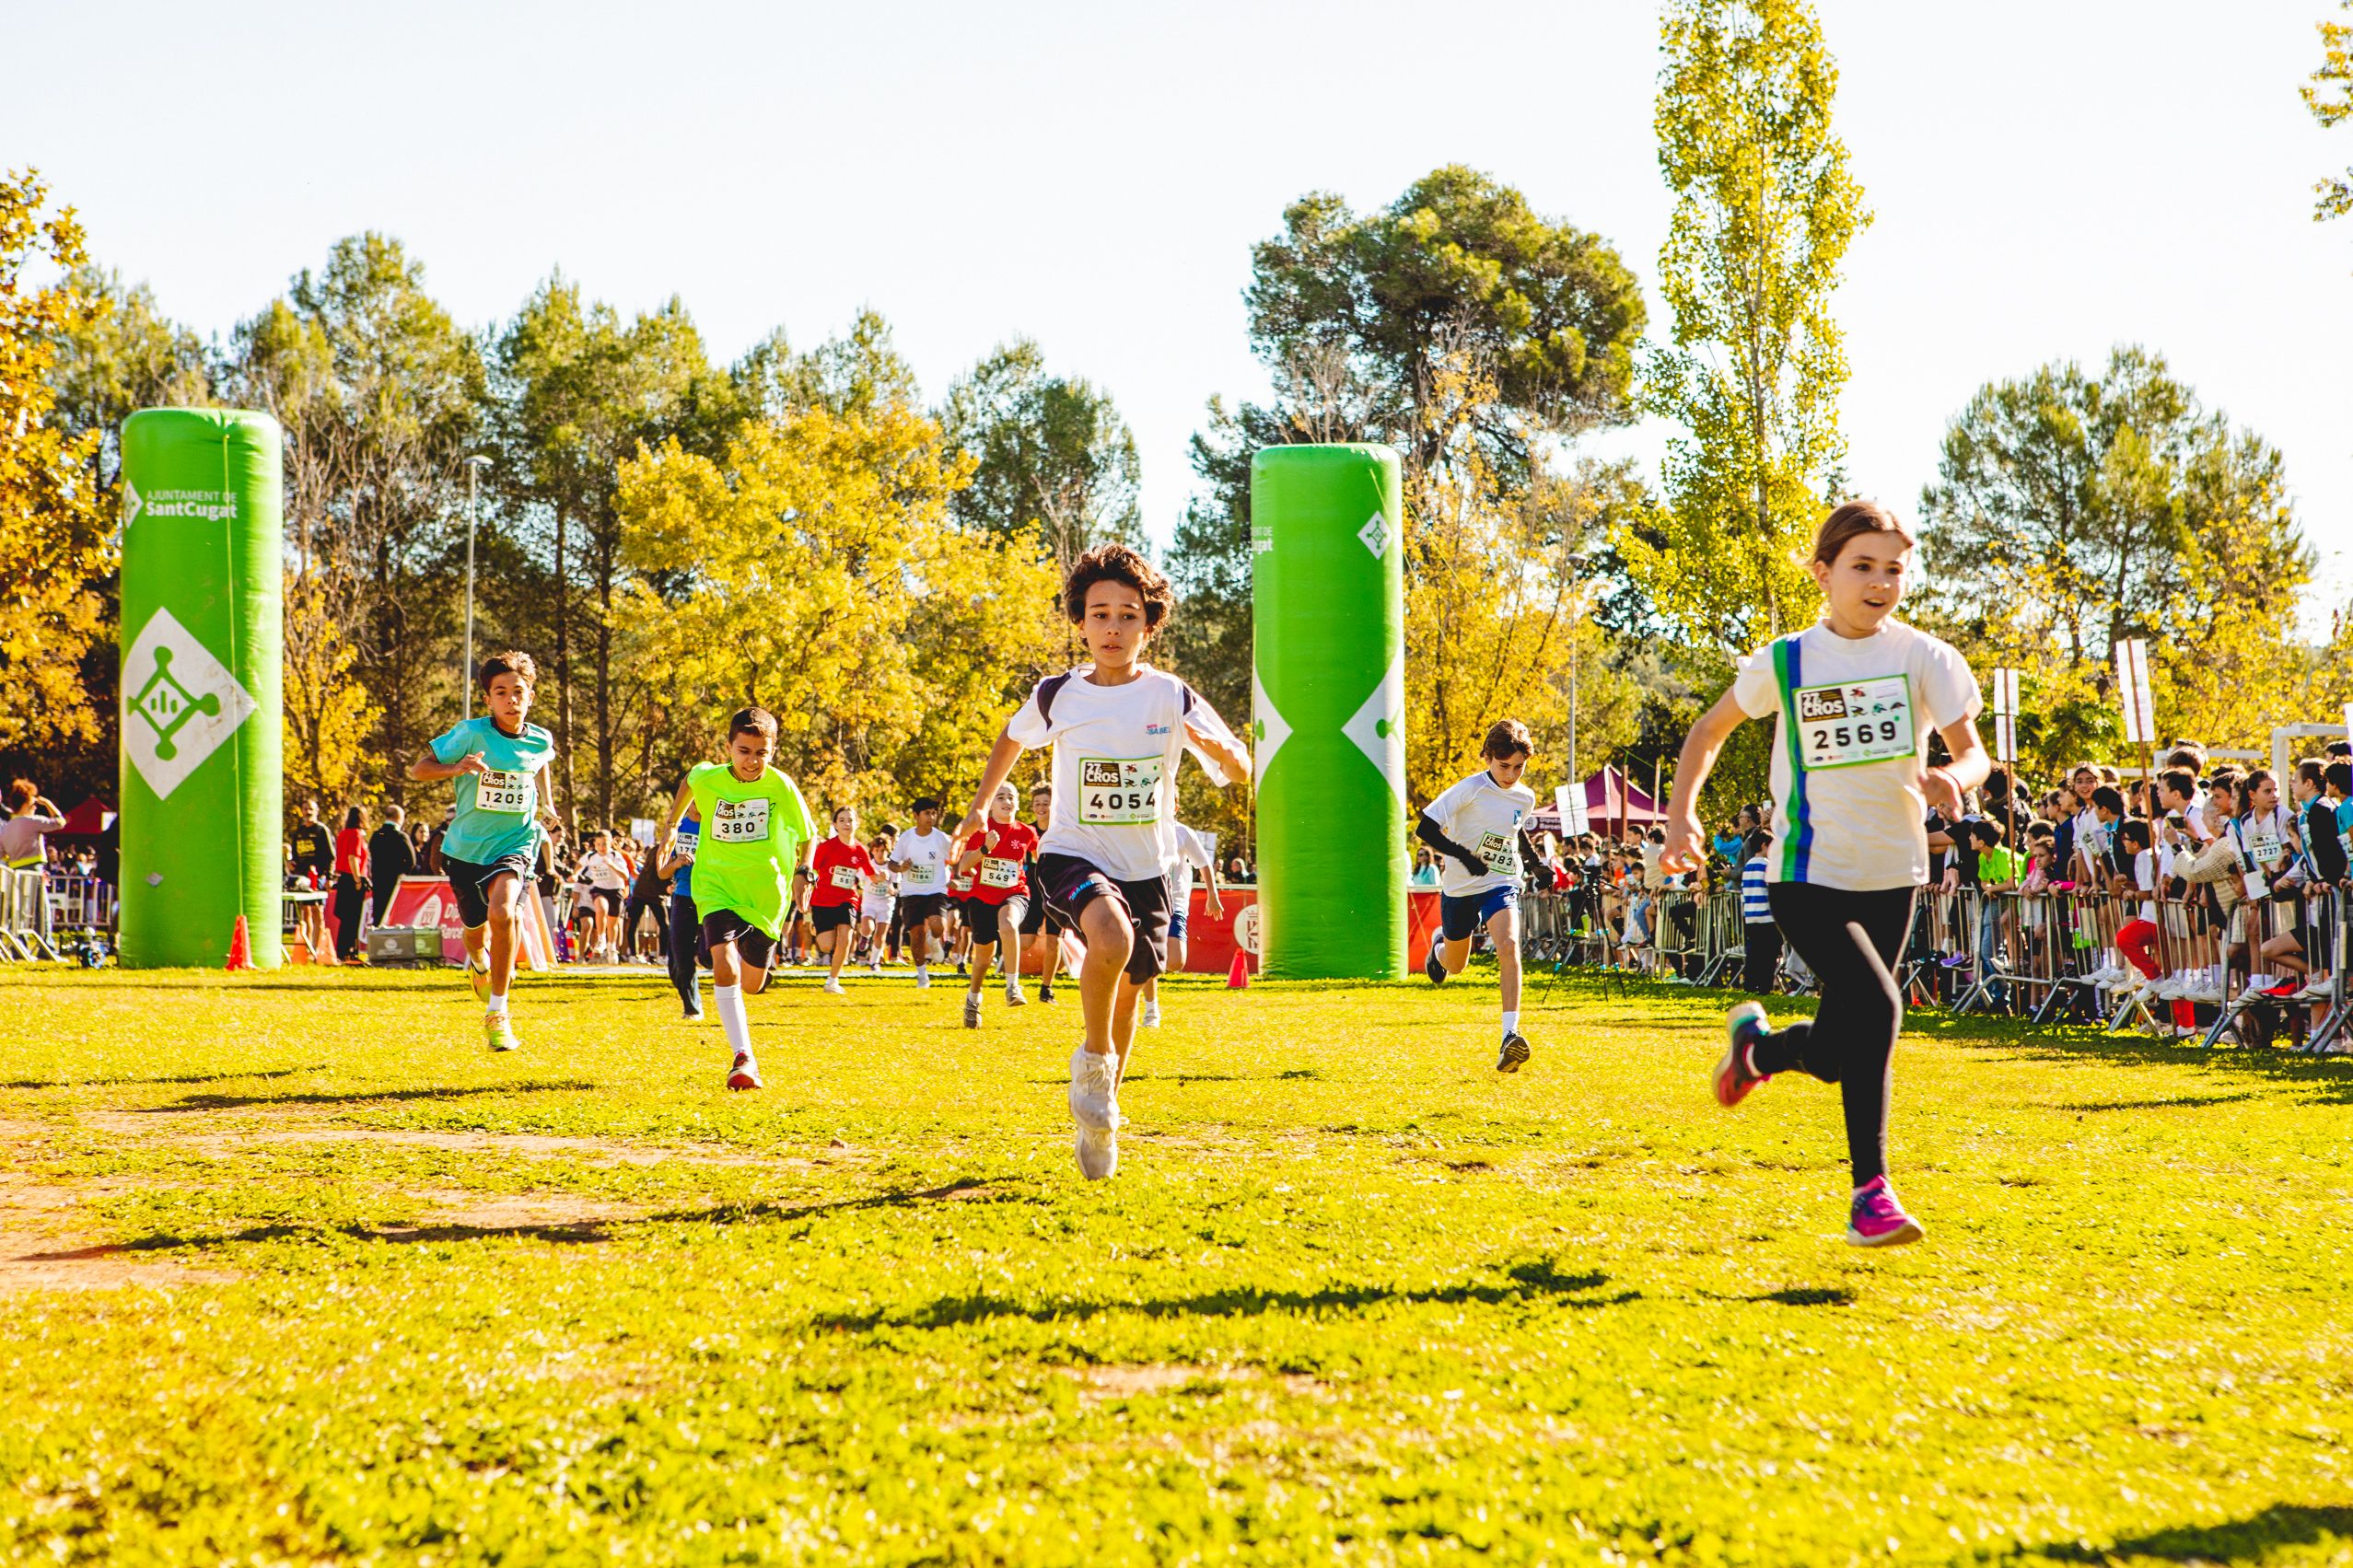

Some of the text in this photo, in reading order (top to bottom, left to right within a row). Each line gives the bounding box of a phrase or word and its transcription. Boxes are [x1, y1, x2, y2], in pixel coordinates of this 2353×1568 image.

[146, 490, 238, 503] AJUNTAMENT DE
[146, 501, 238, 521] SantCugat
[1802, 700, 1845, 717] CROS
[1812, 721, 1897, 749] 2569
[483, 777, 505, 786] CROS
[1085, 772, 1119, 784] CROS
[485, 791, 524, 805] 1209
[1089, 792, 1156, 810] 4054
[721, 821, 755, 834] 380
[1485, 839, 1502, 849] CROS
[1483, 851, 1513, 866] 2183
[988, 872, 1009, 882] 549
